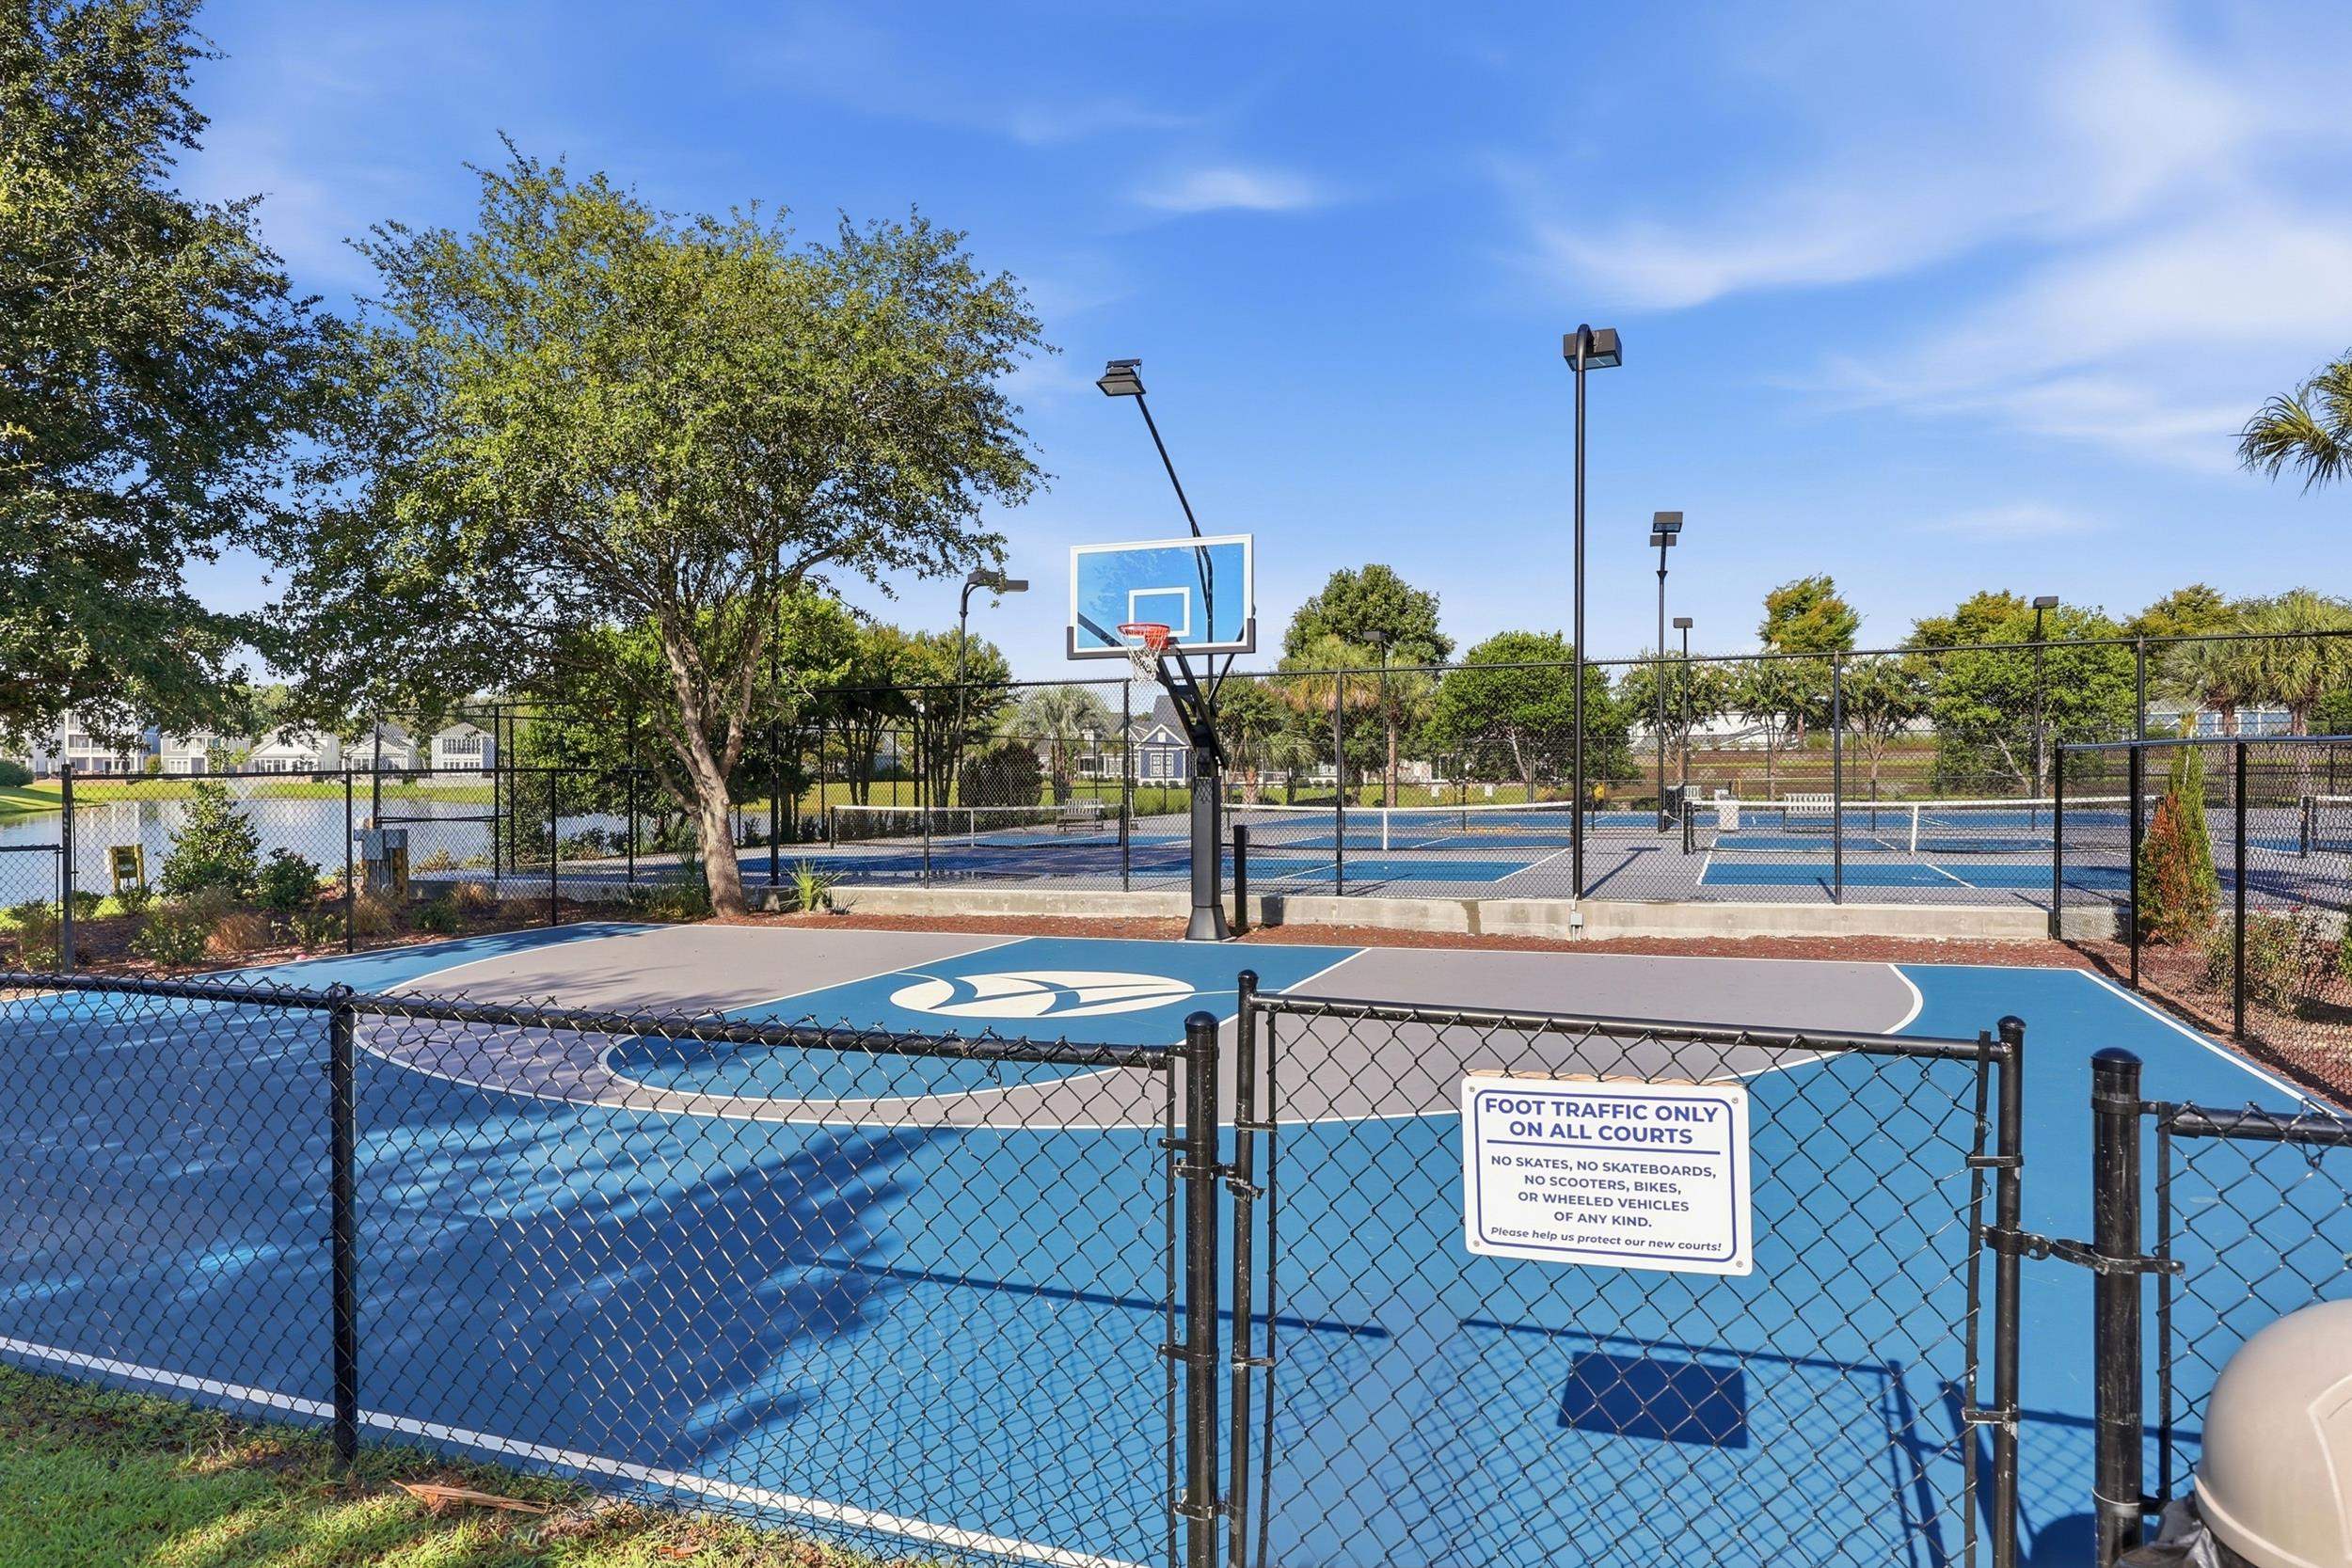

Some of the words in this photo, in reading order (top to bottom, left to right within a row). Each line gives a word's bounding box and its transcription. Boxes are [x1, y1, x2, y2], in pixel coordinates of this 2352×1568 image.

[1486, 1098, 1545, 1115] FOOT
[1550, 1101, 1647, 1120] TRAFFIC
[1655, 1105, 1718, 1122] ONLY
[1510, 1121, 1542, 1137] ON
[1549, 1123, 1592, 1139] ALL
[1598, 1125, 1692, 1144] COURTS
[1492, 1156, 1512, 1165] NO
[1517, 1157, 1572, 1171] SKATES,
[1578, 1161, 1598, 1171] NO
[1603, 1163, 1716, 1179] SKATEBOARDS,
[1525, 1175, 1545, 1185] NO
[1549, 1177, 1629, 1192] SCOOTERS,
[1634, 1181, 1681, 1195] BIKES,
[1518, 1192, 1538, 1202] OR
[1543, 1194, 1613, 1207] WHEELED
[1618, 1198, 1689, 1212] VEHICLES
[1554, 1212, 1573, 1221] OF
[1578, 1213, 1607, 1224] ANY
[1613, 1215, 1651, 1227] KIND.
[1491, 1227, 1529, 1237] Please
[1533, 1230, 1557, 1242] help
[1562, 1233, 1574, 1242] us
[1578, 1236, 1621, 1244] protect
[1625, 1238, 1645, 1247] our
[1648, 1240, 1675, 1249] new
[1678, 1242, 1721, 1251] courts!
